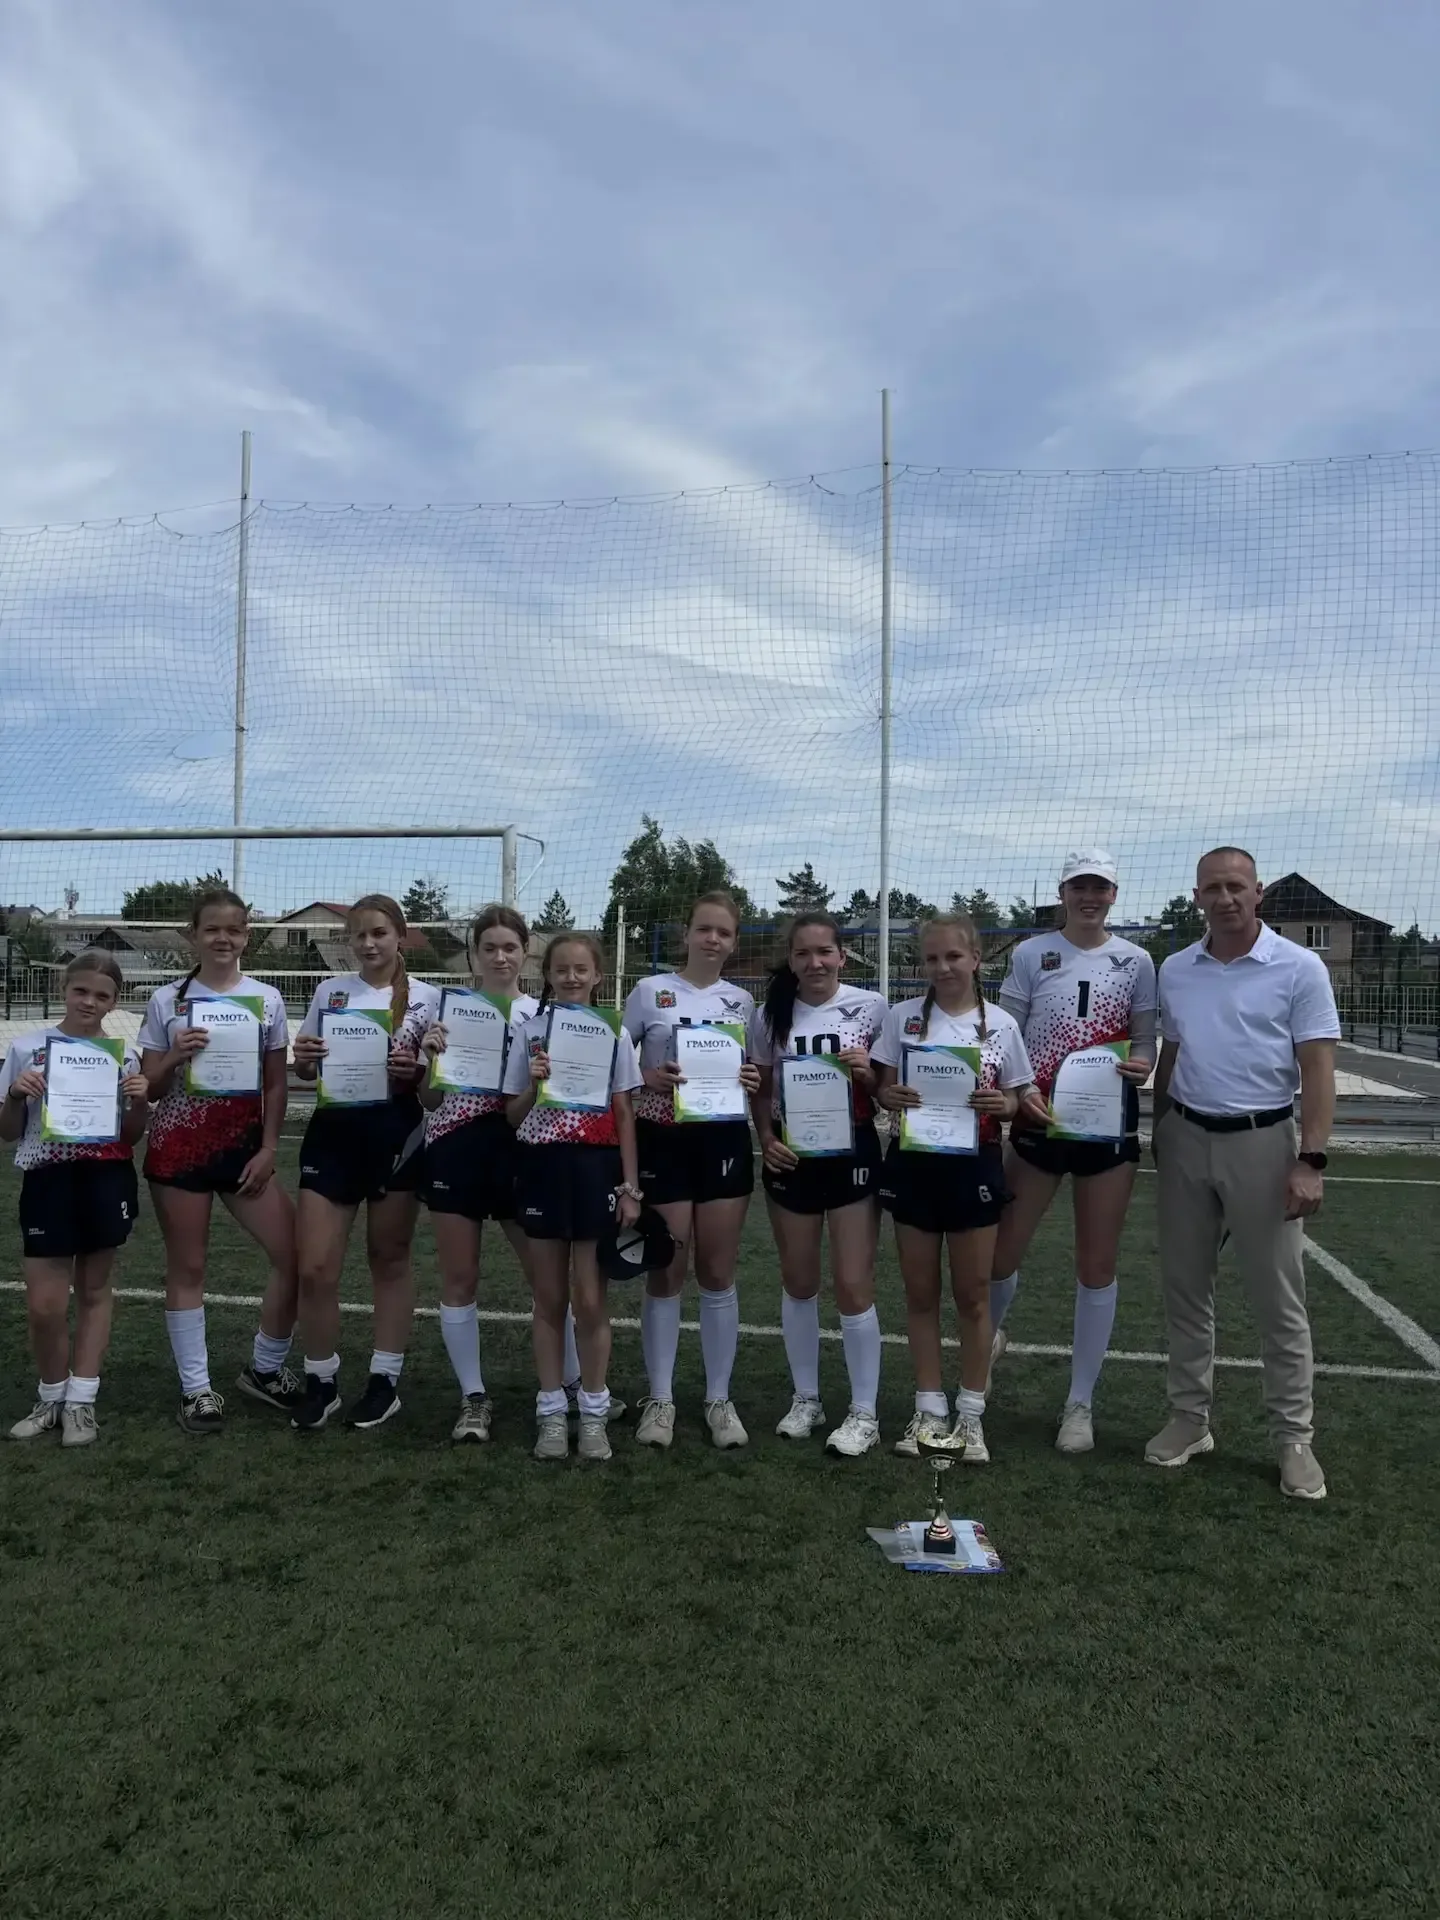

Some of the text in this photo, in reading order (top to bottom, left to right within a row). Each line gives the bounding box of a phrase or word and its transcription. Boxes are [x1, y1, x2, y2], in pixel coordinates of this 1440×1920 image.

[1077, 980, 1090, 1018] 1
[202, 1013, 250, 1022] ГРАМОТА
[452, 1007, 497, 1021] ГРАМОТА
[332, 1027, 379, 1036] ГРАМОТА
[561, 1022, 607, 1036] ГРАМОТА
[686, 1039, 732, 1049] ГРАМОТА
[60, 1055, 109, 1066] ГРАМОТА
[1070, 1056, 1114, 1066] ГРАМОТА
[917, 1065, 966, 1076] ГРАМОТА
[793, 1072, 839, 1082] ГРАМОТА
[852, 1167, 869, 1186] 10
[607, 1193, 617, 1212] 3
[120, 1201, 130, 1220] 2
